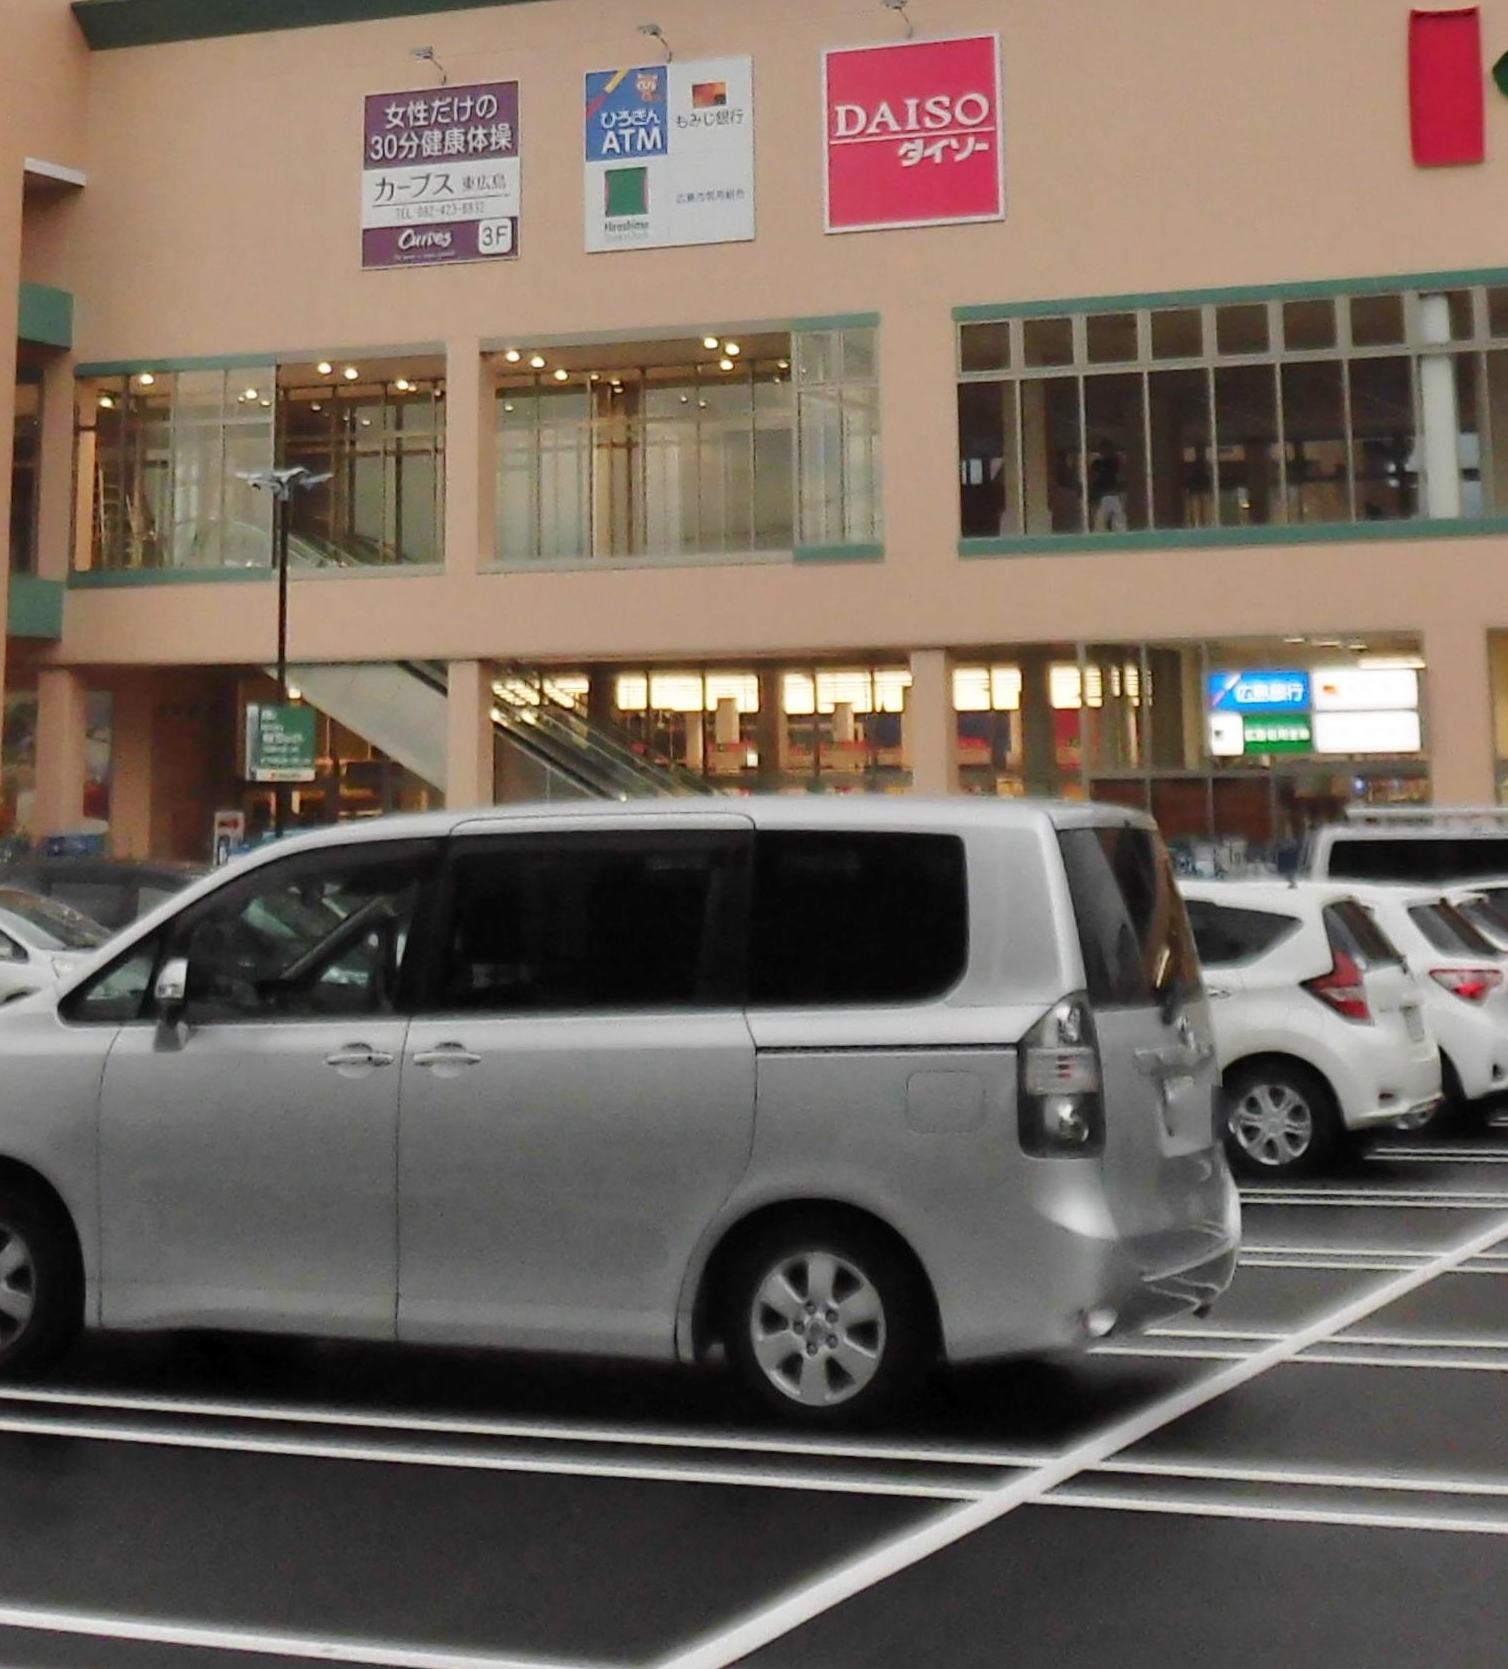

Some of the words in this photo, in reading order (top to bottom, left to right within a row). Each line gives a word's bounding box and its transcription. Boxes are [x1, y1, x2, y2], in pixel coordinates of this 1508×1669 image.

[385, 94, 498, 129] 女性だけの
[600, 108, 661, 129] ひろぎん
[676, 108, 745, 129] もみじ銀行
[834, 93, 991, 137] DAISO
[369, 122, 513, 161] 30分健康体操
[601, 126, 663, 156] ATM
[897, 136, 990, 168] ダイソー
[374, 173, 454, 202] カーブス
[481, 225, 509, 247] 3F
